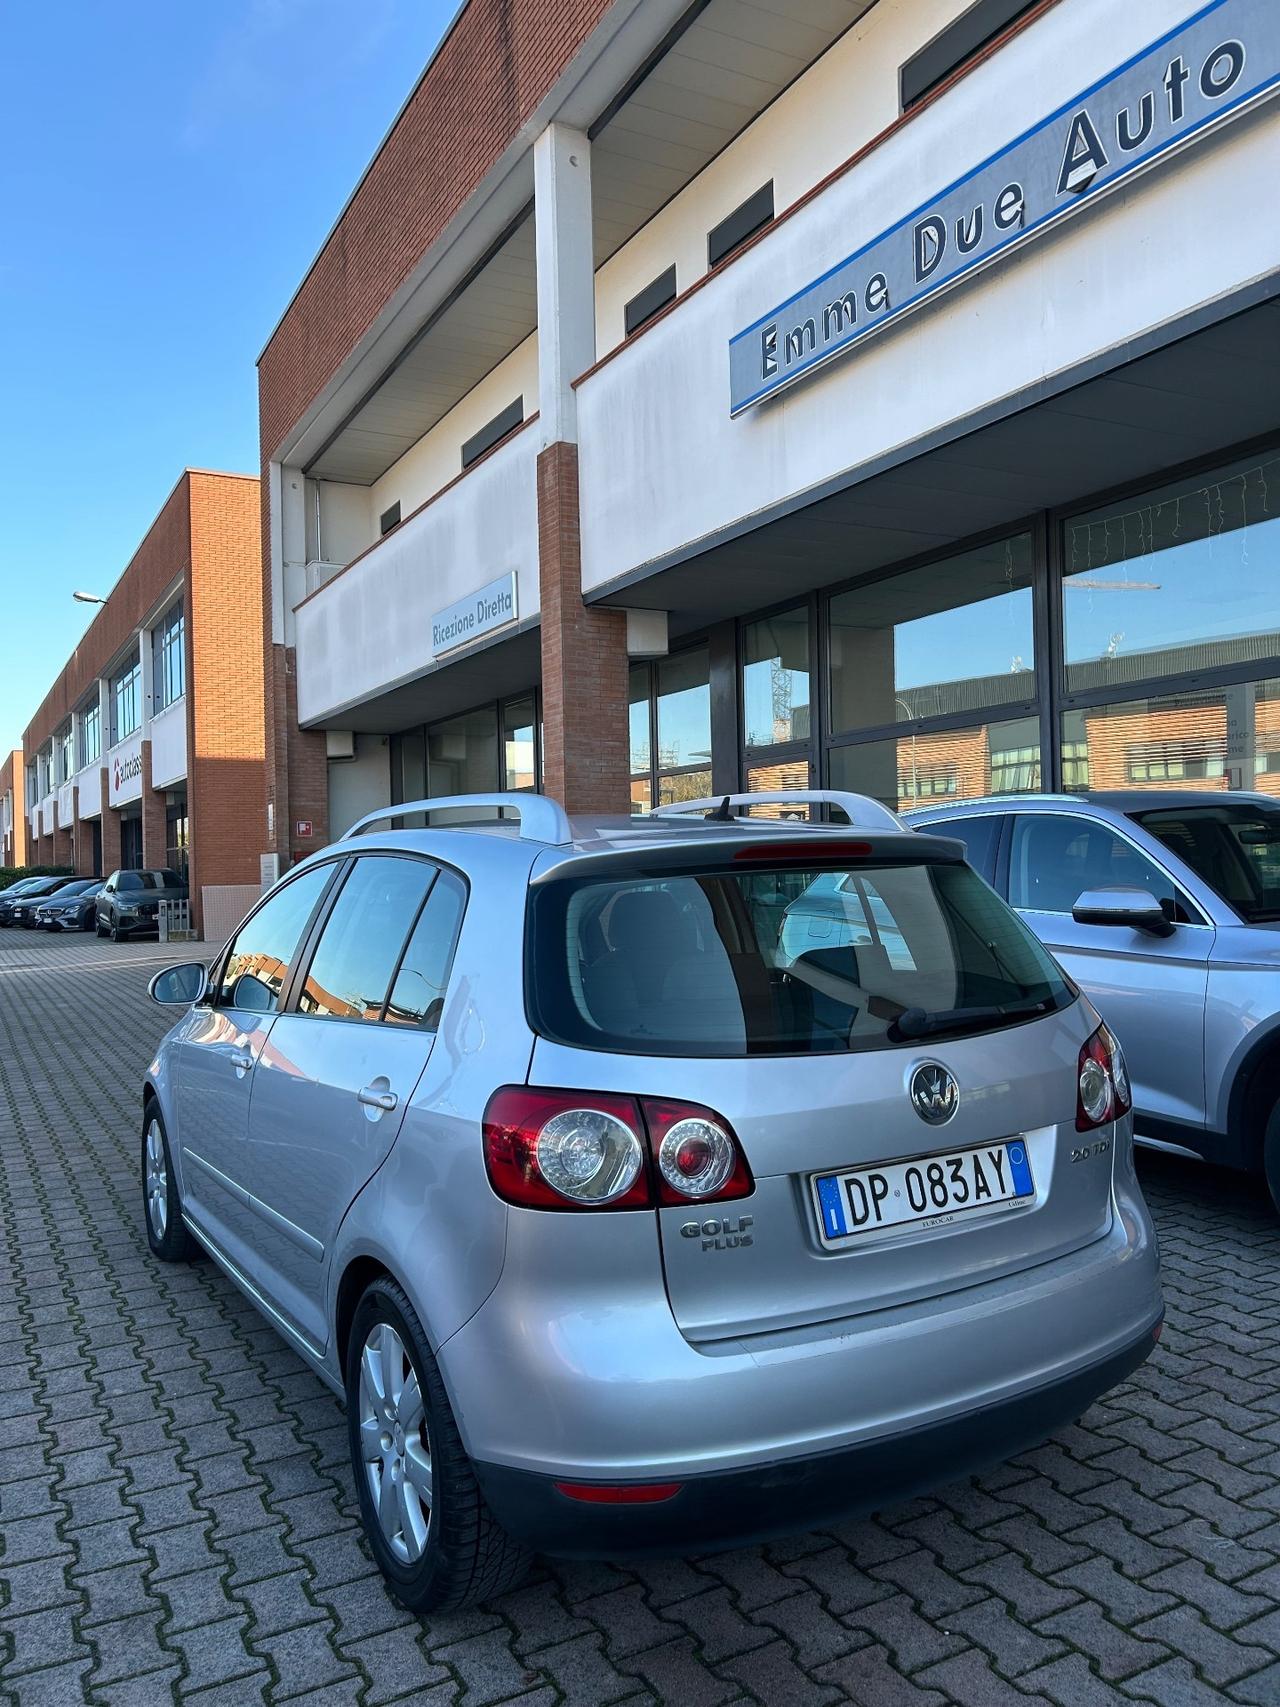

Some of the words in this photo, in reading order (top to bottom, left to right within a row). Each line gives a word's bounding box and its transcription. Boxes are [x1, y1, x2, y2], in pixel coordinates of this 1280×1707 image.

[760, 271, 888, 380] Emme
[913, 182, 1024, 284] Due
[1055, 38, 1246, 197] Auto
[432, 612, 475, 646] Ricezione
[477, 592, 512, 624] Diretta
[844, 1173, 889, 1226] DP
[905, 1149, 1007, 1213] 083AY
[680, 1214, 754, 1238] GOLF
[922, 1216, 954, 1228] EUROCAR
[702, 1234, 754, 1252] PLUS
